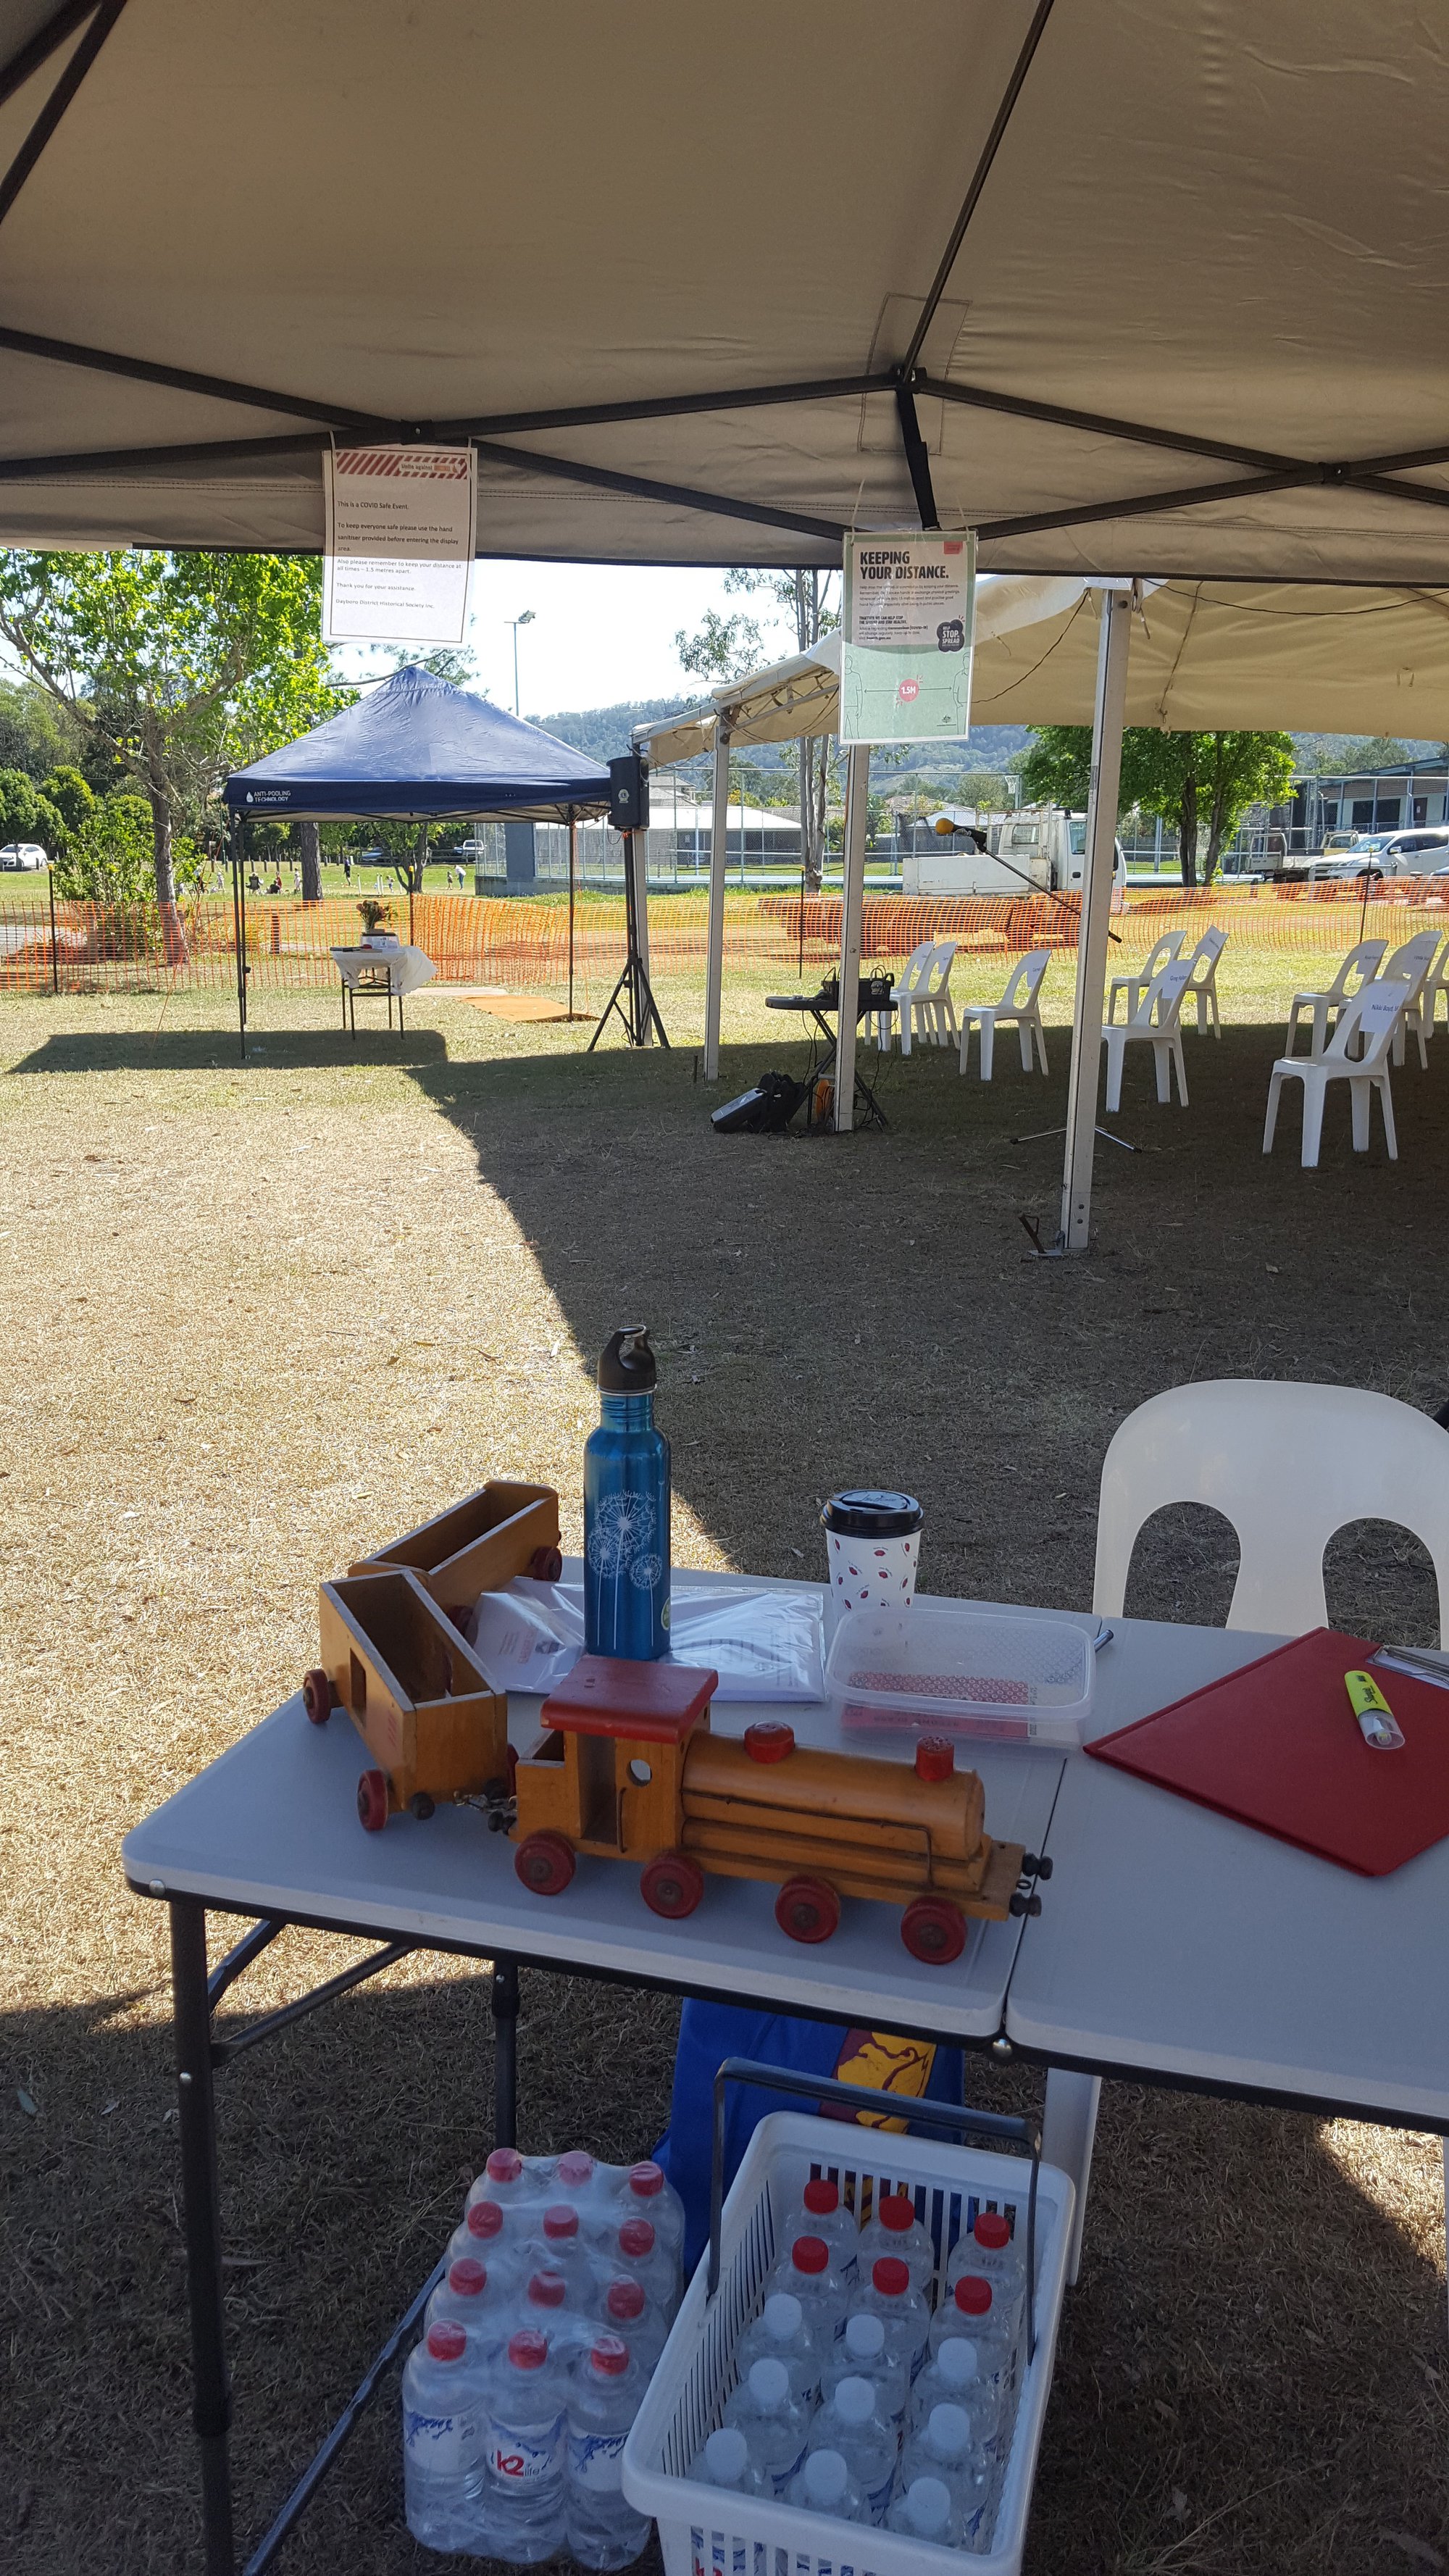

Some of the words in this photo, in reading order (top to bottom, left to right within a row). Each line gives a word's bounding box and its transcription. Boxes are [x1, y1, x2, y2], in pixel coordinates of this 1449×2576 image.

[860, 551, 910, 564] KEEPING
[860, 567, 892, 580] YOUR
[895, 566, 949, 579] DISTANCE.
